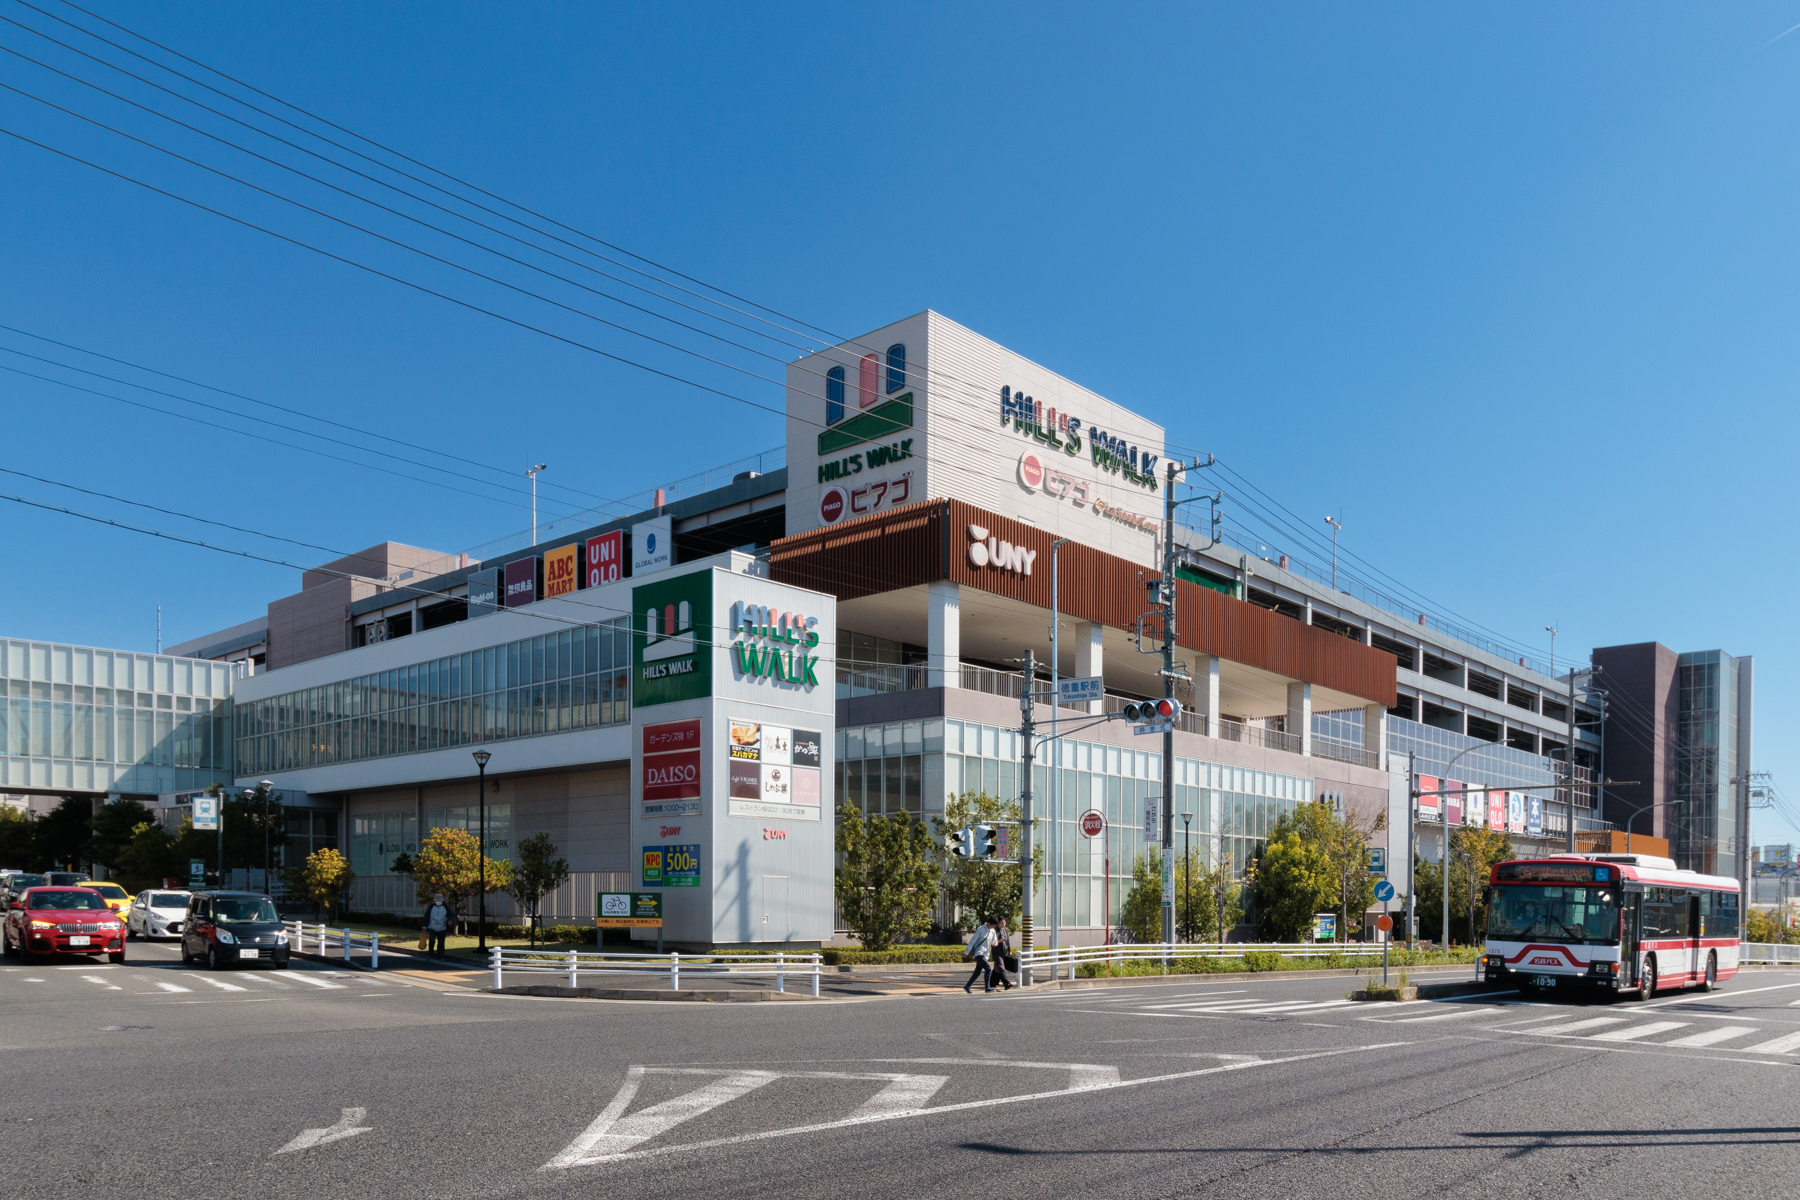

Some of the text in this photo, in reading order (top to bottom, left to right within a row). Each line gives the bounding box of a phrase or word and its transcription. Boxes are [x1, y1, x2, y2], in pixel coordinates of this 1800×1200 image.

[1001, 385, 1159, 490] HILL'S WALK
[818, 438, 913, 484] HILL'S WALK
[1025, 466, 1040, 477] PIAGO
[850, 471, 913, 514] ピアゴ
[1046, 469, 1090, 504] ピアゴ
[823, 502, 841, 512] PIAGO
[591, 539, 615, 565] UNI
[988, 537, 1037, 576] UNY
[548, 555, 574, 583] ABC
[635, 554, 669, 569] GLOBAL WORK
[508, 579, 533, 596] 無印良品
[547, 577, 574, 598] MART
[736, 600, 819, 648] HILL'S
[642, 659, 693, 680] HILL'S WALK
[737, 640, 820, 687] WALK
[1061, 681, 1100, 693] 徳重駅前
[686, 730, 695, 740] 1F
[647, 764, 696, 785] DAISO
[764, 781, 788, 794] しゃぶ葉
[1490, 793, 1502, 808] UNI
[1084, 819, 1102, 830] 消火栓
[1490, 810, 1503, 828] QLO
[666, 826, 681, 837] UNY
[771, 829, 789, 840] UNY
[491, 839, 509, 849] WORK
[645, 853, 661, 867] NPC
[666, 852, 698, 871] 500円
[1533, 957, 1559, 965] 名鉄バス
